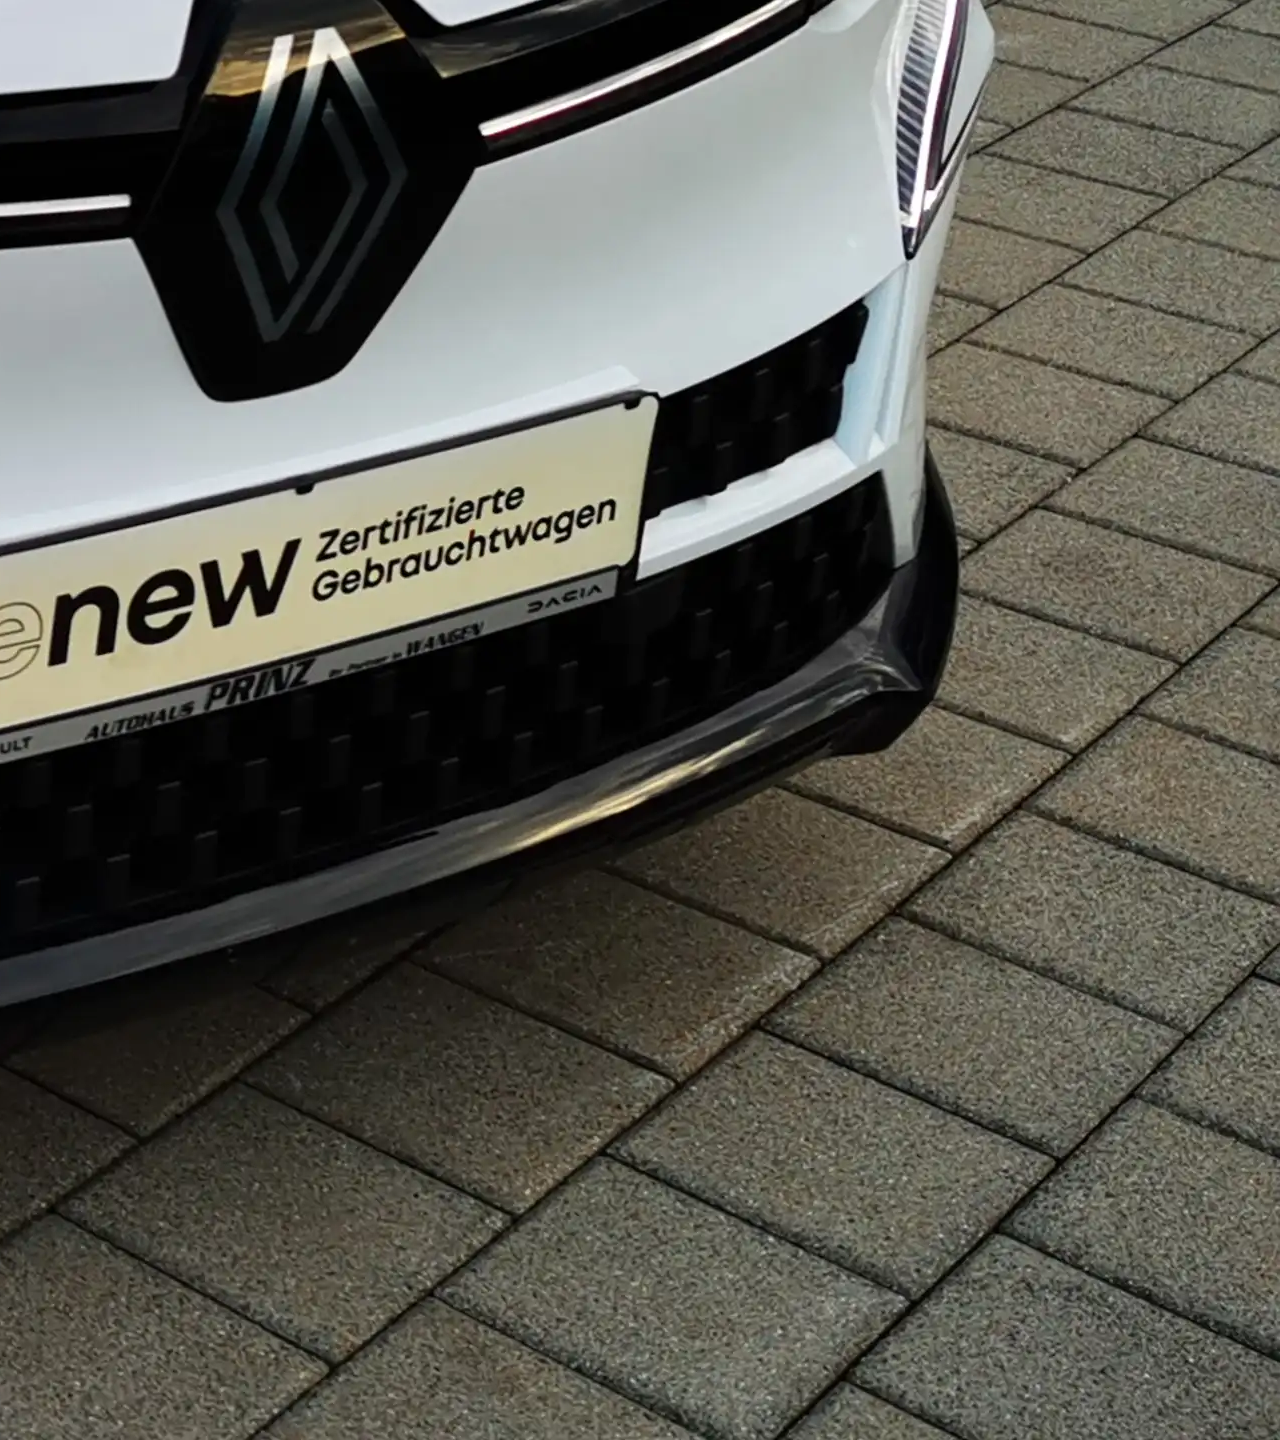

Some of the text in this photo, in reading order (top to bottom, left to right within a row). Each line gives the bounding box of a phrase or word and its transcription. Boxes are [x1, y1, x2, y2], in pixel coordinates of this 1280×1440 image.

[312, 497, 617, 602] Gebrauchtwagen
[315, 485, 525, 563] Zertifizierte
[84, 700, 196, 741] AUTOHAUS
[203, 658, 317, 713] PRINZ
[406, 620, 485, 657] WANGEN
[527, 583, 603, 613] DACIA
